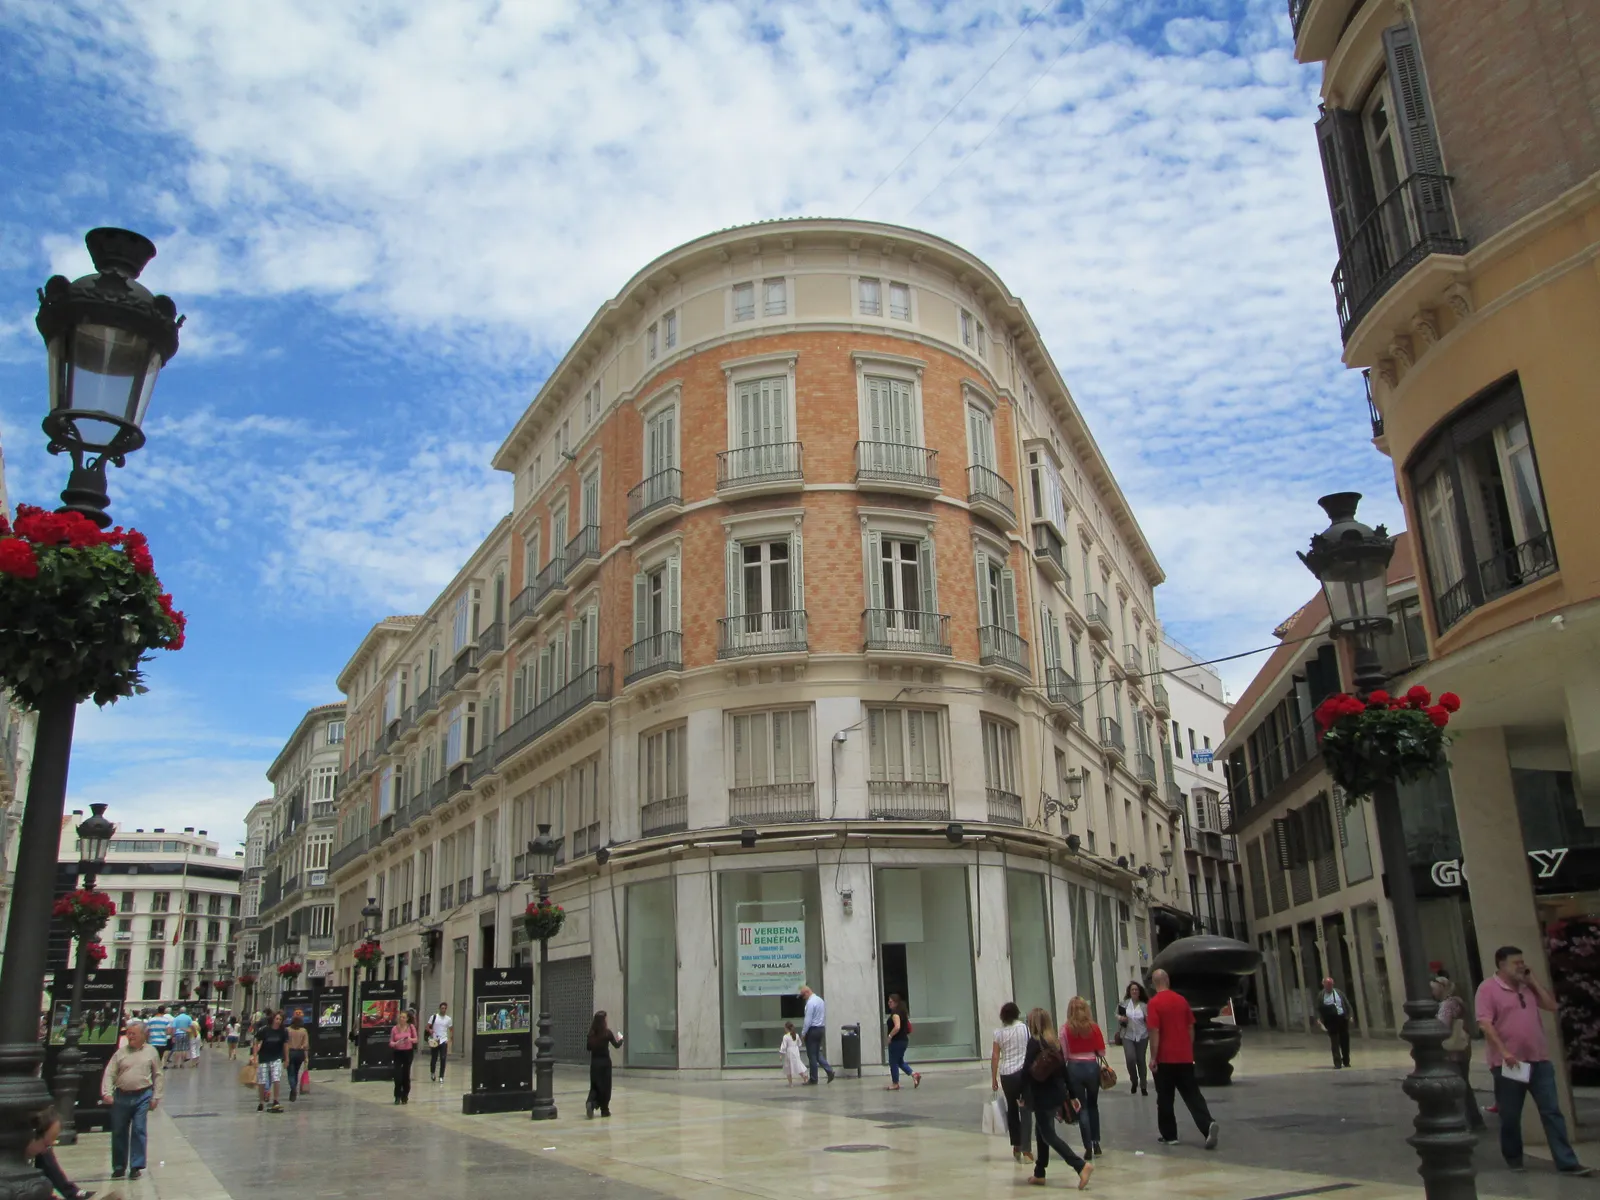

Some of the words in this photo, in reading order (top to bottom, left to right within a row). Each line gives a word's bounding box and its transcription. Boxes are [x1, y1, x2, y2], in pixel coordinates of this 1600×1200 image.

[754, 927, 798, 935] VERBENA
[740, 928, 751, 945] III
[754, 935, 800, 944] BENÉFICA
